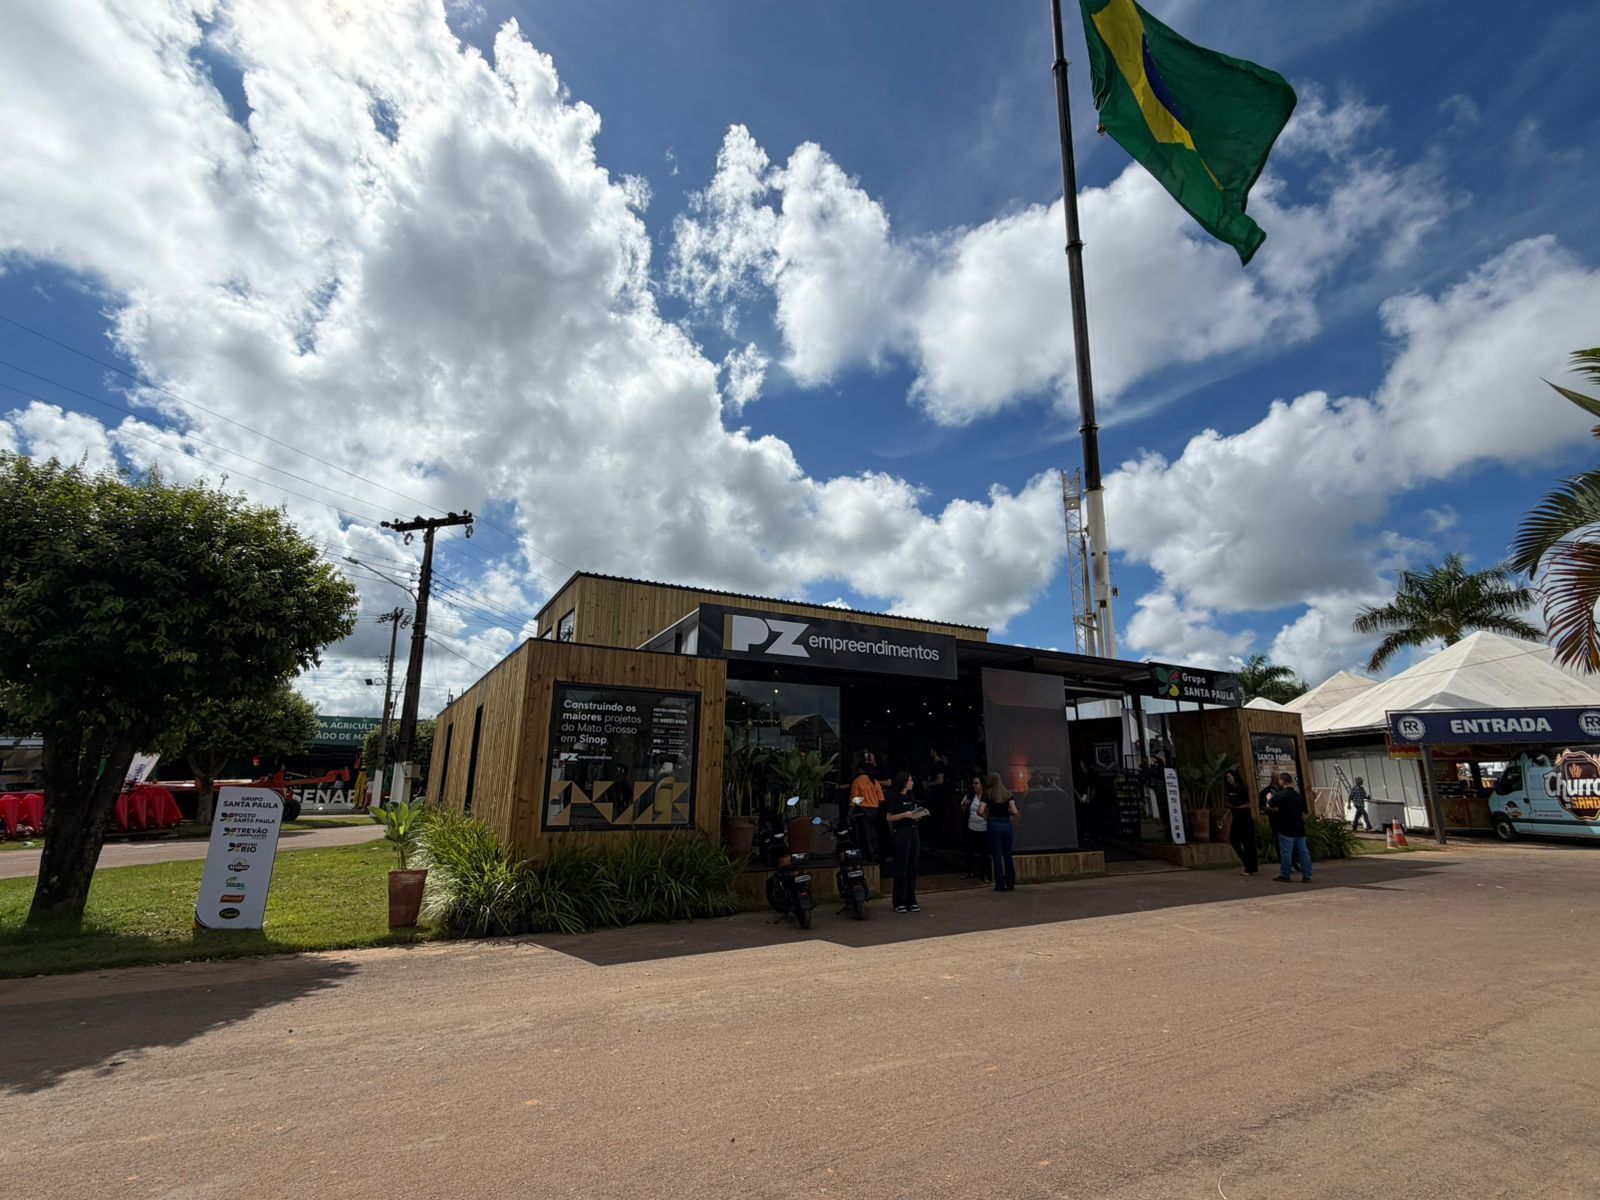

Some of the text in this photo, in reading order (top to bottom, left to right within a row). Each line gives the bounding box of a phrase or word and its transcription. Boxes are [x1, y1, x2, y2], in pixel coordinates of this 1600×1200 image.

[725, 614, 940, 662] PZ empreendimentos
[1182, 673, 1207, 686] Grupo
[1184, 687, 1236, 701] SANTA PAULA
[563, 699, 637, 713] Construindo os
[562, 712, 602, 722] maiores
[604, 714, 642, 725] projetos
[330, 722, 376, 730] AGRICULT
[561, 722, 638, 735] do Mato Grosso
[1403, 721, 1419, 731] RR
[1450, 717, 1553, 734] ENTRADA
[579, 734, 609, 746] Sinop.
[1265, 745, 1282, 754] Grupo
[560, 752, 578, 762] PZ
[1256, 752, 1275, 761] SANTA
